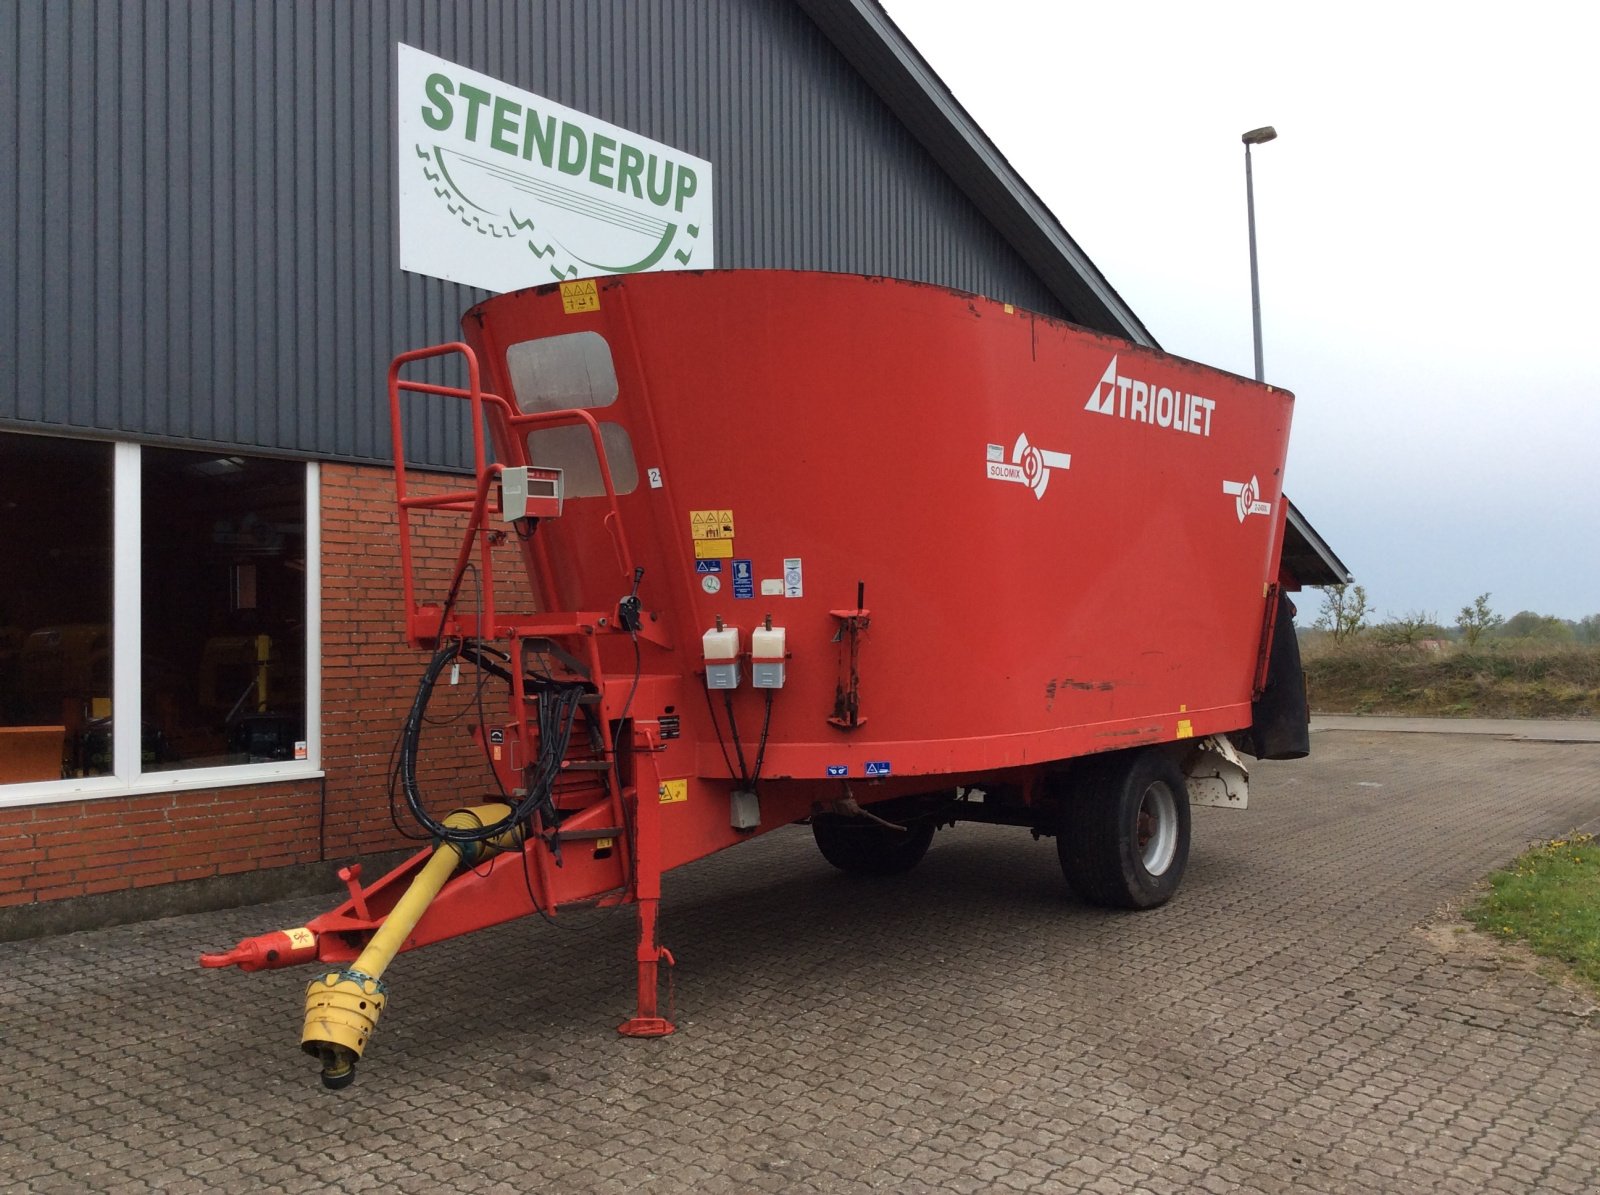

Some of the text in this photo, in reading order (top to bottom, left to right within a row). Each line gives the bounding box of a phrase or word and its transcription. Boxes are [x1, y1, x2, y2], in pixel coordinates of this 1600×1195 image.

[421, 72, 698, 213] STENDERUP
[1117, 375, 1216, 437] TRIOLIET
[650, 471, 659, 482] 2
[990, 465, 1020, 479] SOLOMIX
